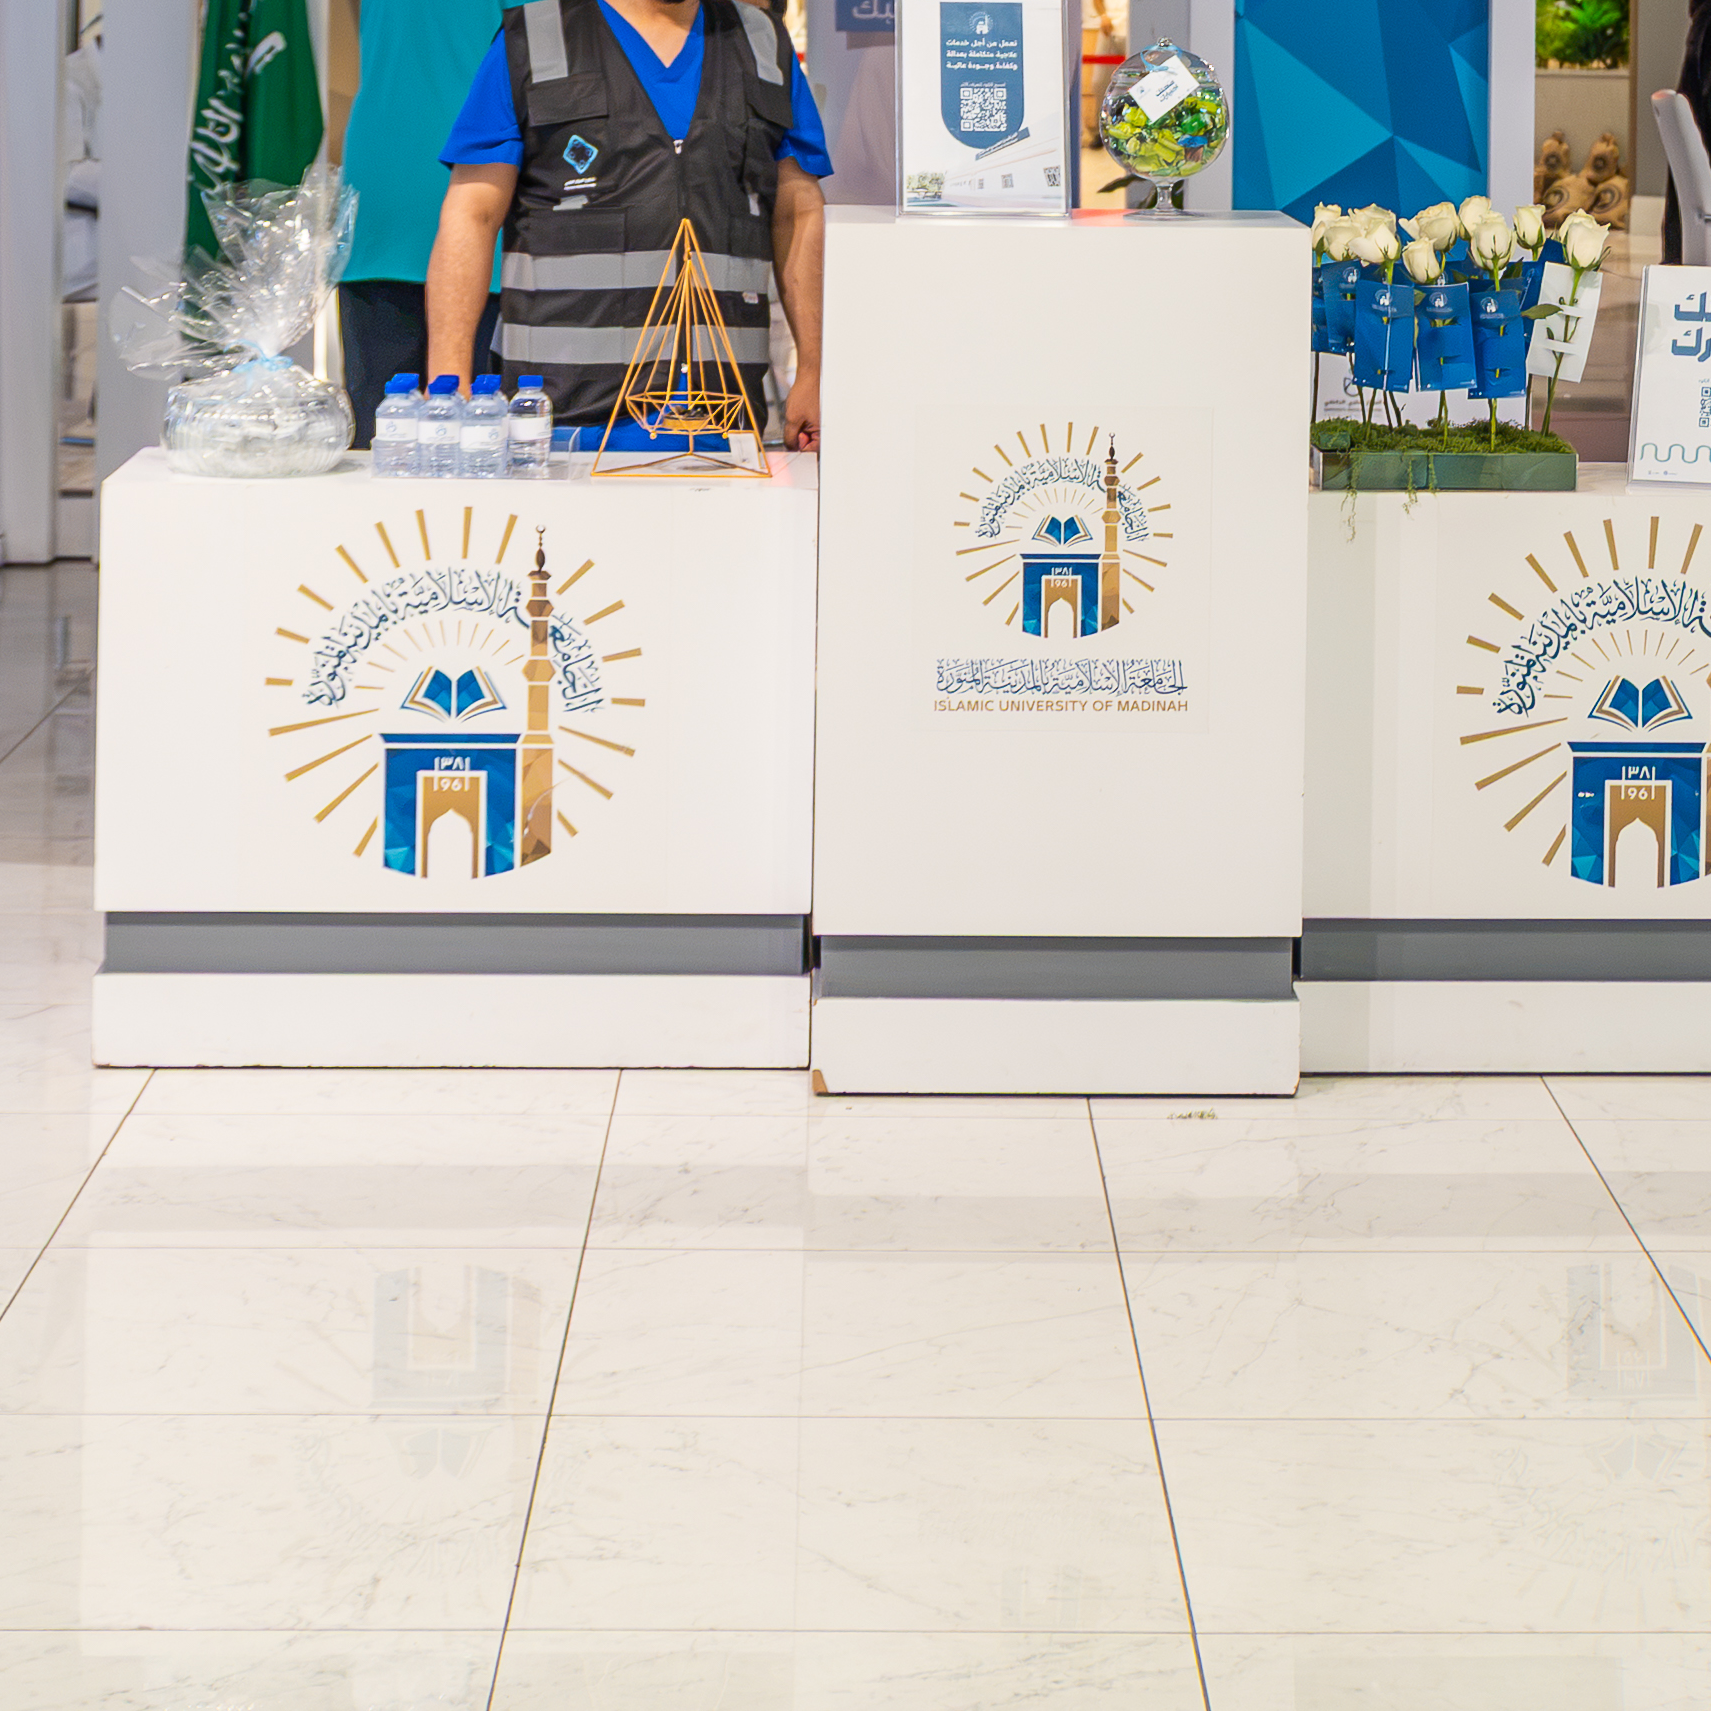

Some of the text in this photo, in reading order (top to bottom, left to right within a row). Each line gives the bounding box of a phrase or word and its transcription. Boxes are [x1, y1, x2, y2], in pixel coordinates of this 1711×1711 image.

[933, 700, 1188, 712] ISLAMIC UNIVERSITY OF MADINAH
[433, 777, 470, 792] 1961
[1621, 785, 1656, 800] 1961
